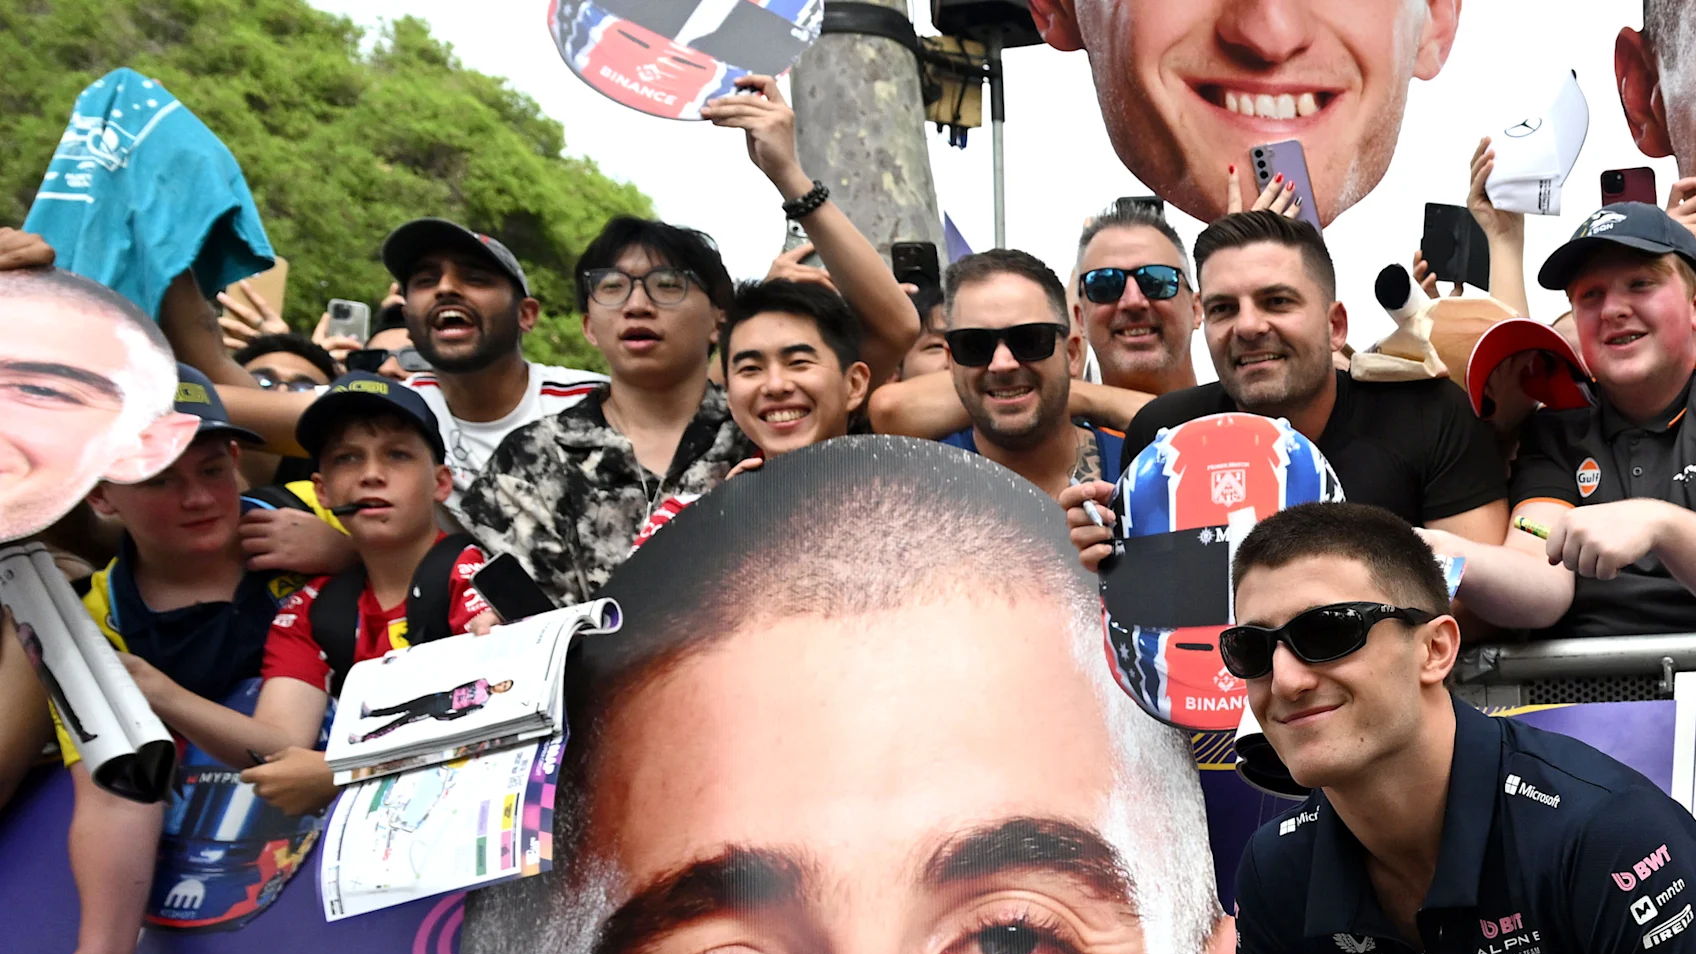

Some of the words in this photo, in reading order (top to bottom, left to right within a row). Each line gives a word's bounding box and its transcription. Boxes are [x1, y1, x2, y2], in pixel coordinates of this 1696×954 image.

[599, 65, 678, 105] BINANCE
[1578, 472, 1600, 484] Gulf
[1518, 782, 1561, 809] Microsoft
[1633, 844, 1671, 881] BWT
[1656, 878, 1685, 906] mntn
